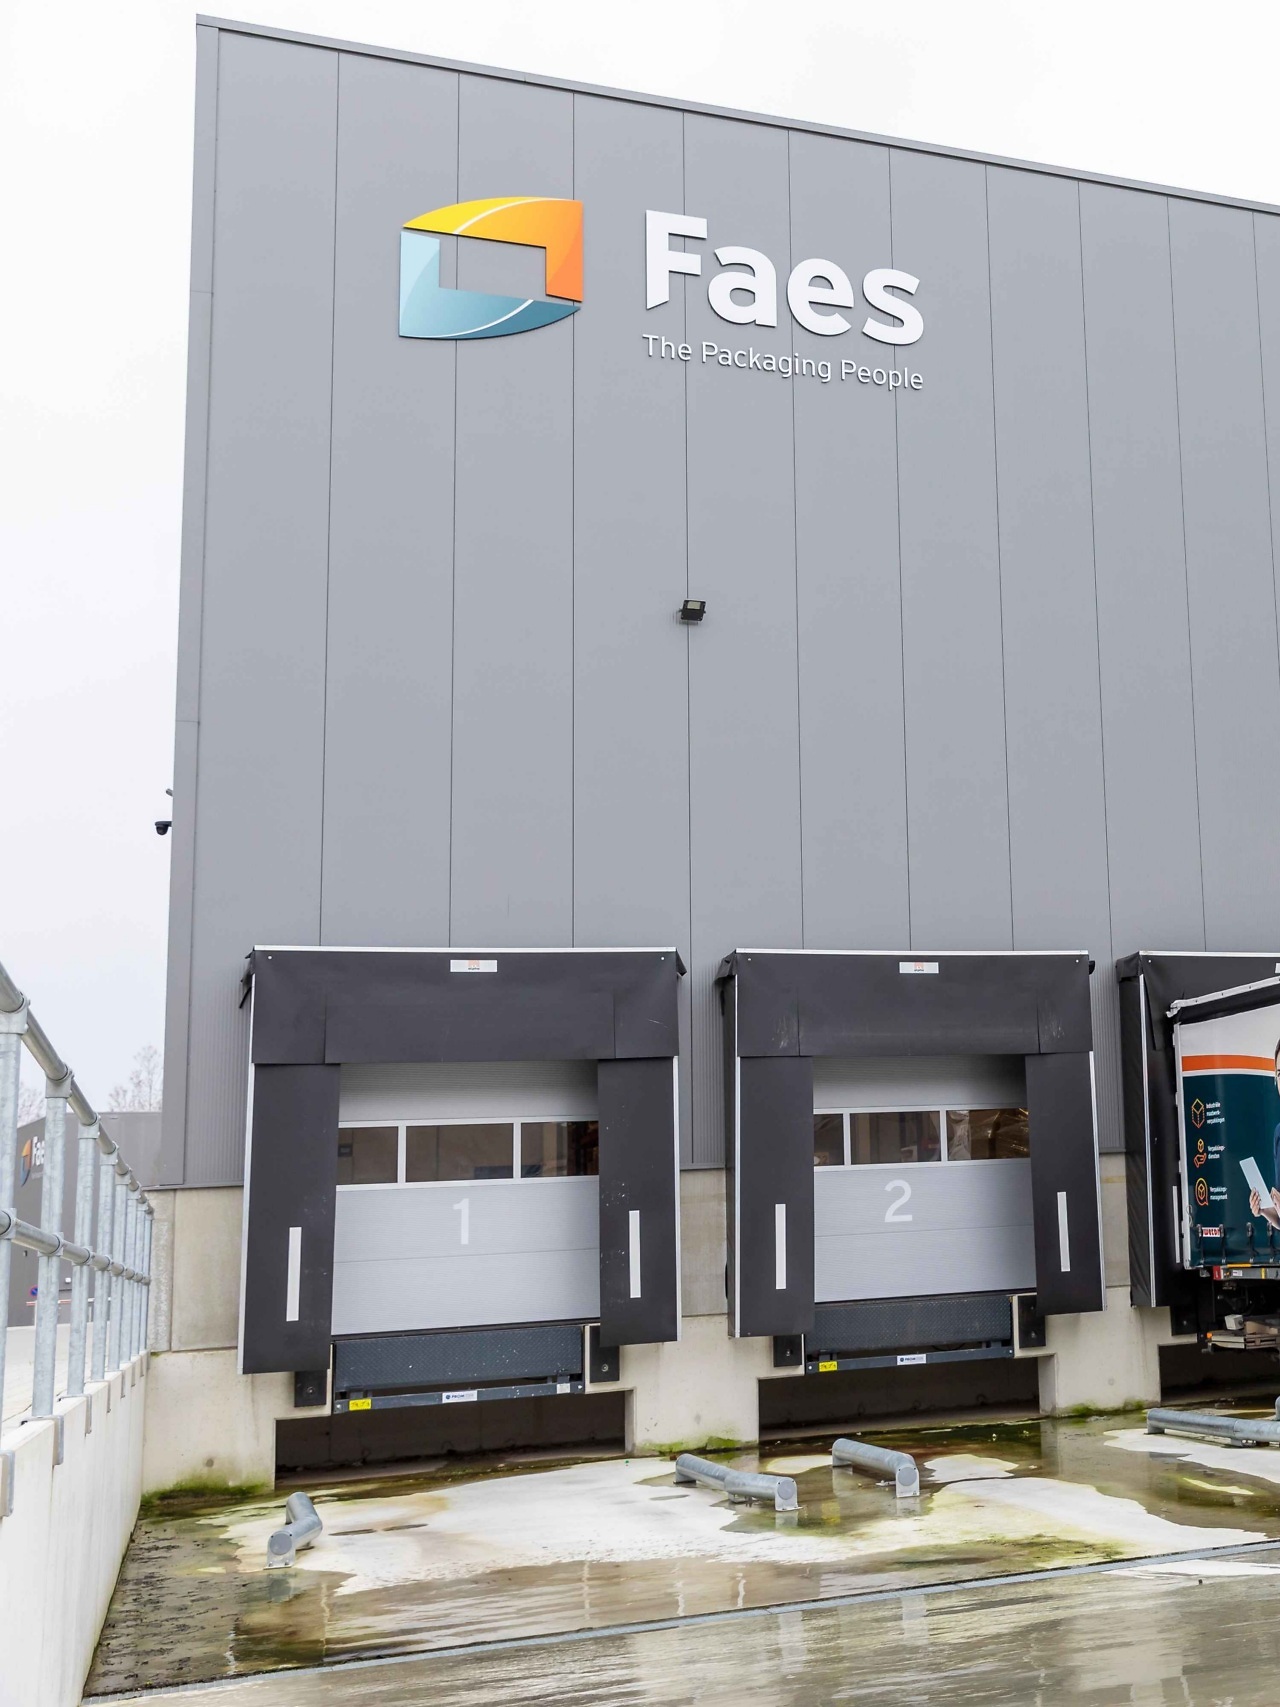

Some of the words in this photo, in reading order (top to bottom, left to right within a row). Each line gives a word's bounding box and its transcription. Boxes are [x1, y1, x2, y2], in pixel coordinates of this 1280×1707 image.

[646, 210, 924, 346] Faes
[642, 334, 692, 361] The
[702, 341, 832, 383] Packaging
[841, 359, 924, 391] People
[453, 1198, 469, 1245] 1
[884, 1179, 912, 1222] 2
